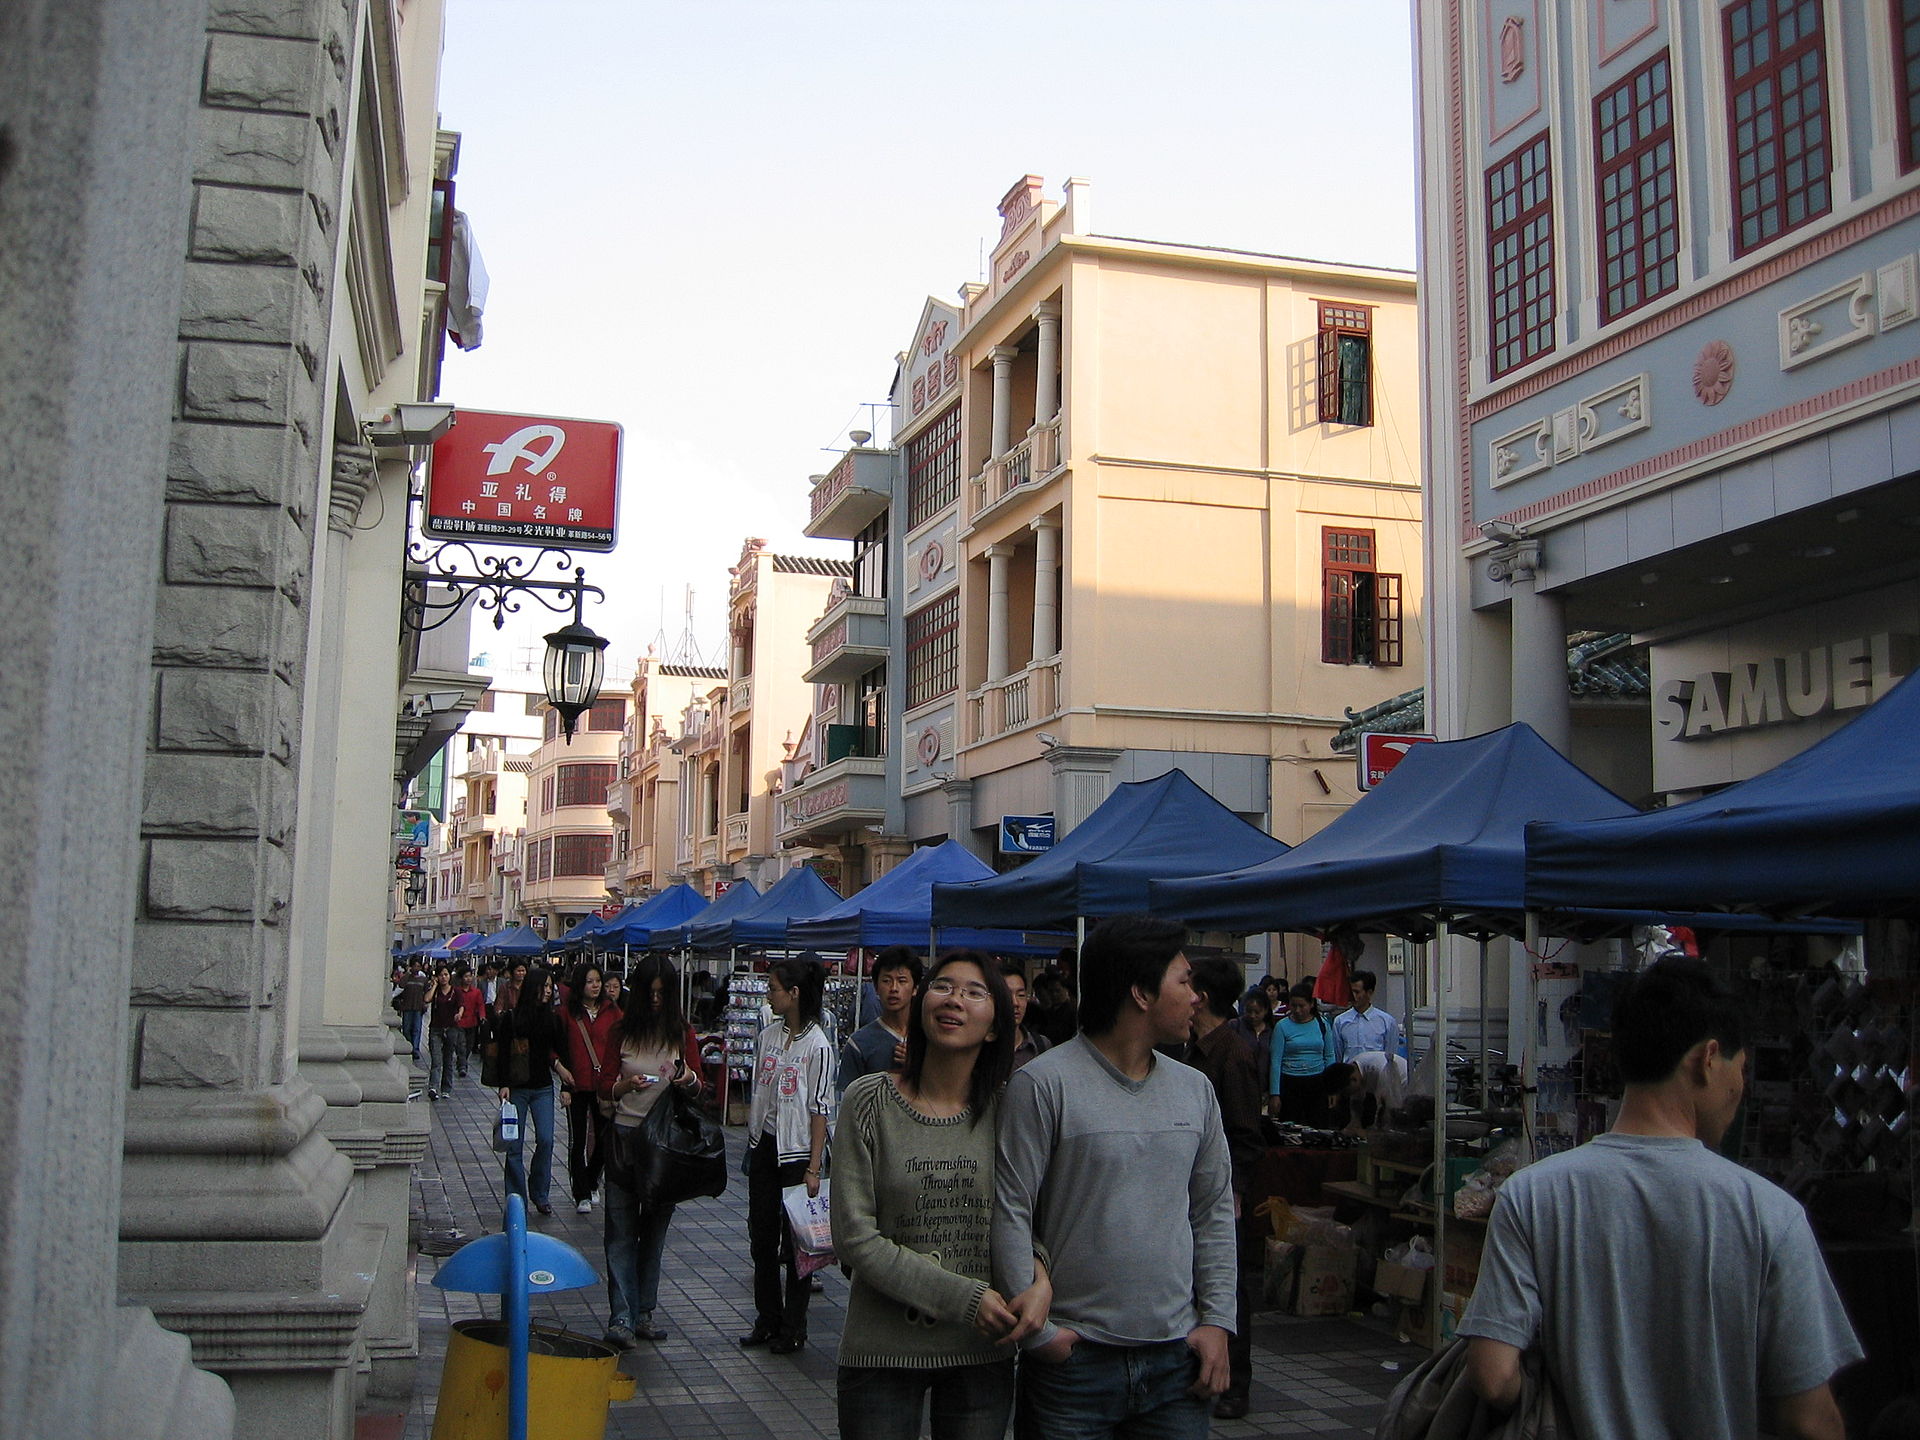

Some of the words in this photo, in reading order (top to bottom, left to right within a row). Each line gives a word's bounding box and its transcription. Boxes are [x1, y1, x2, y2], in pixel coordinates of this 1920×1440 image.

[480, 481, 567, 504] 亚礼得
[462, 500, 583, 523] 中国名牌
[1657, 632, 1905, 741] SAMUEL
[921, 1173, 959, 1193] Through
[961, 1176, 975, 1189] me
